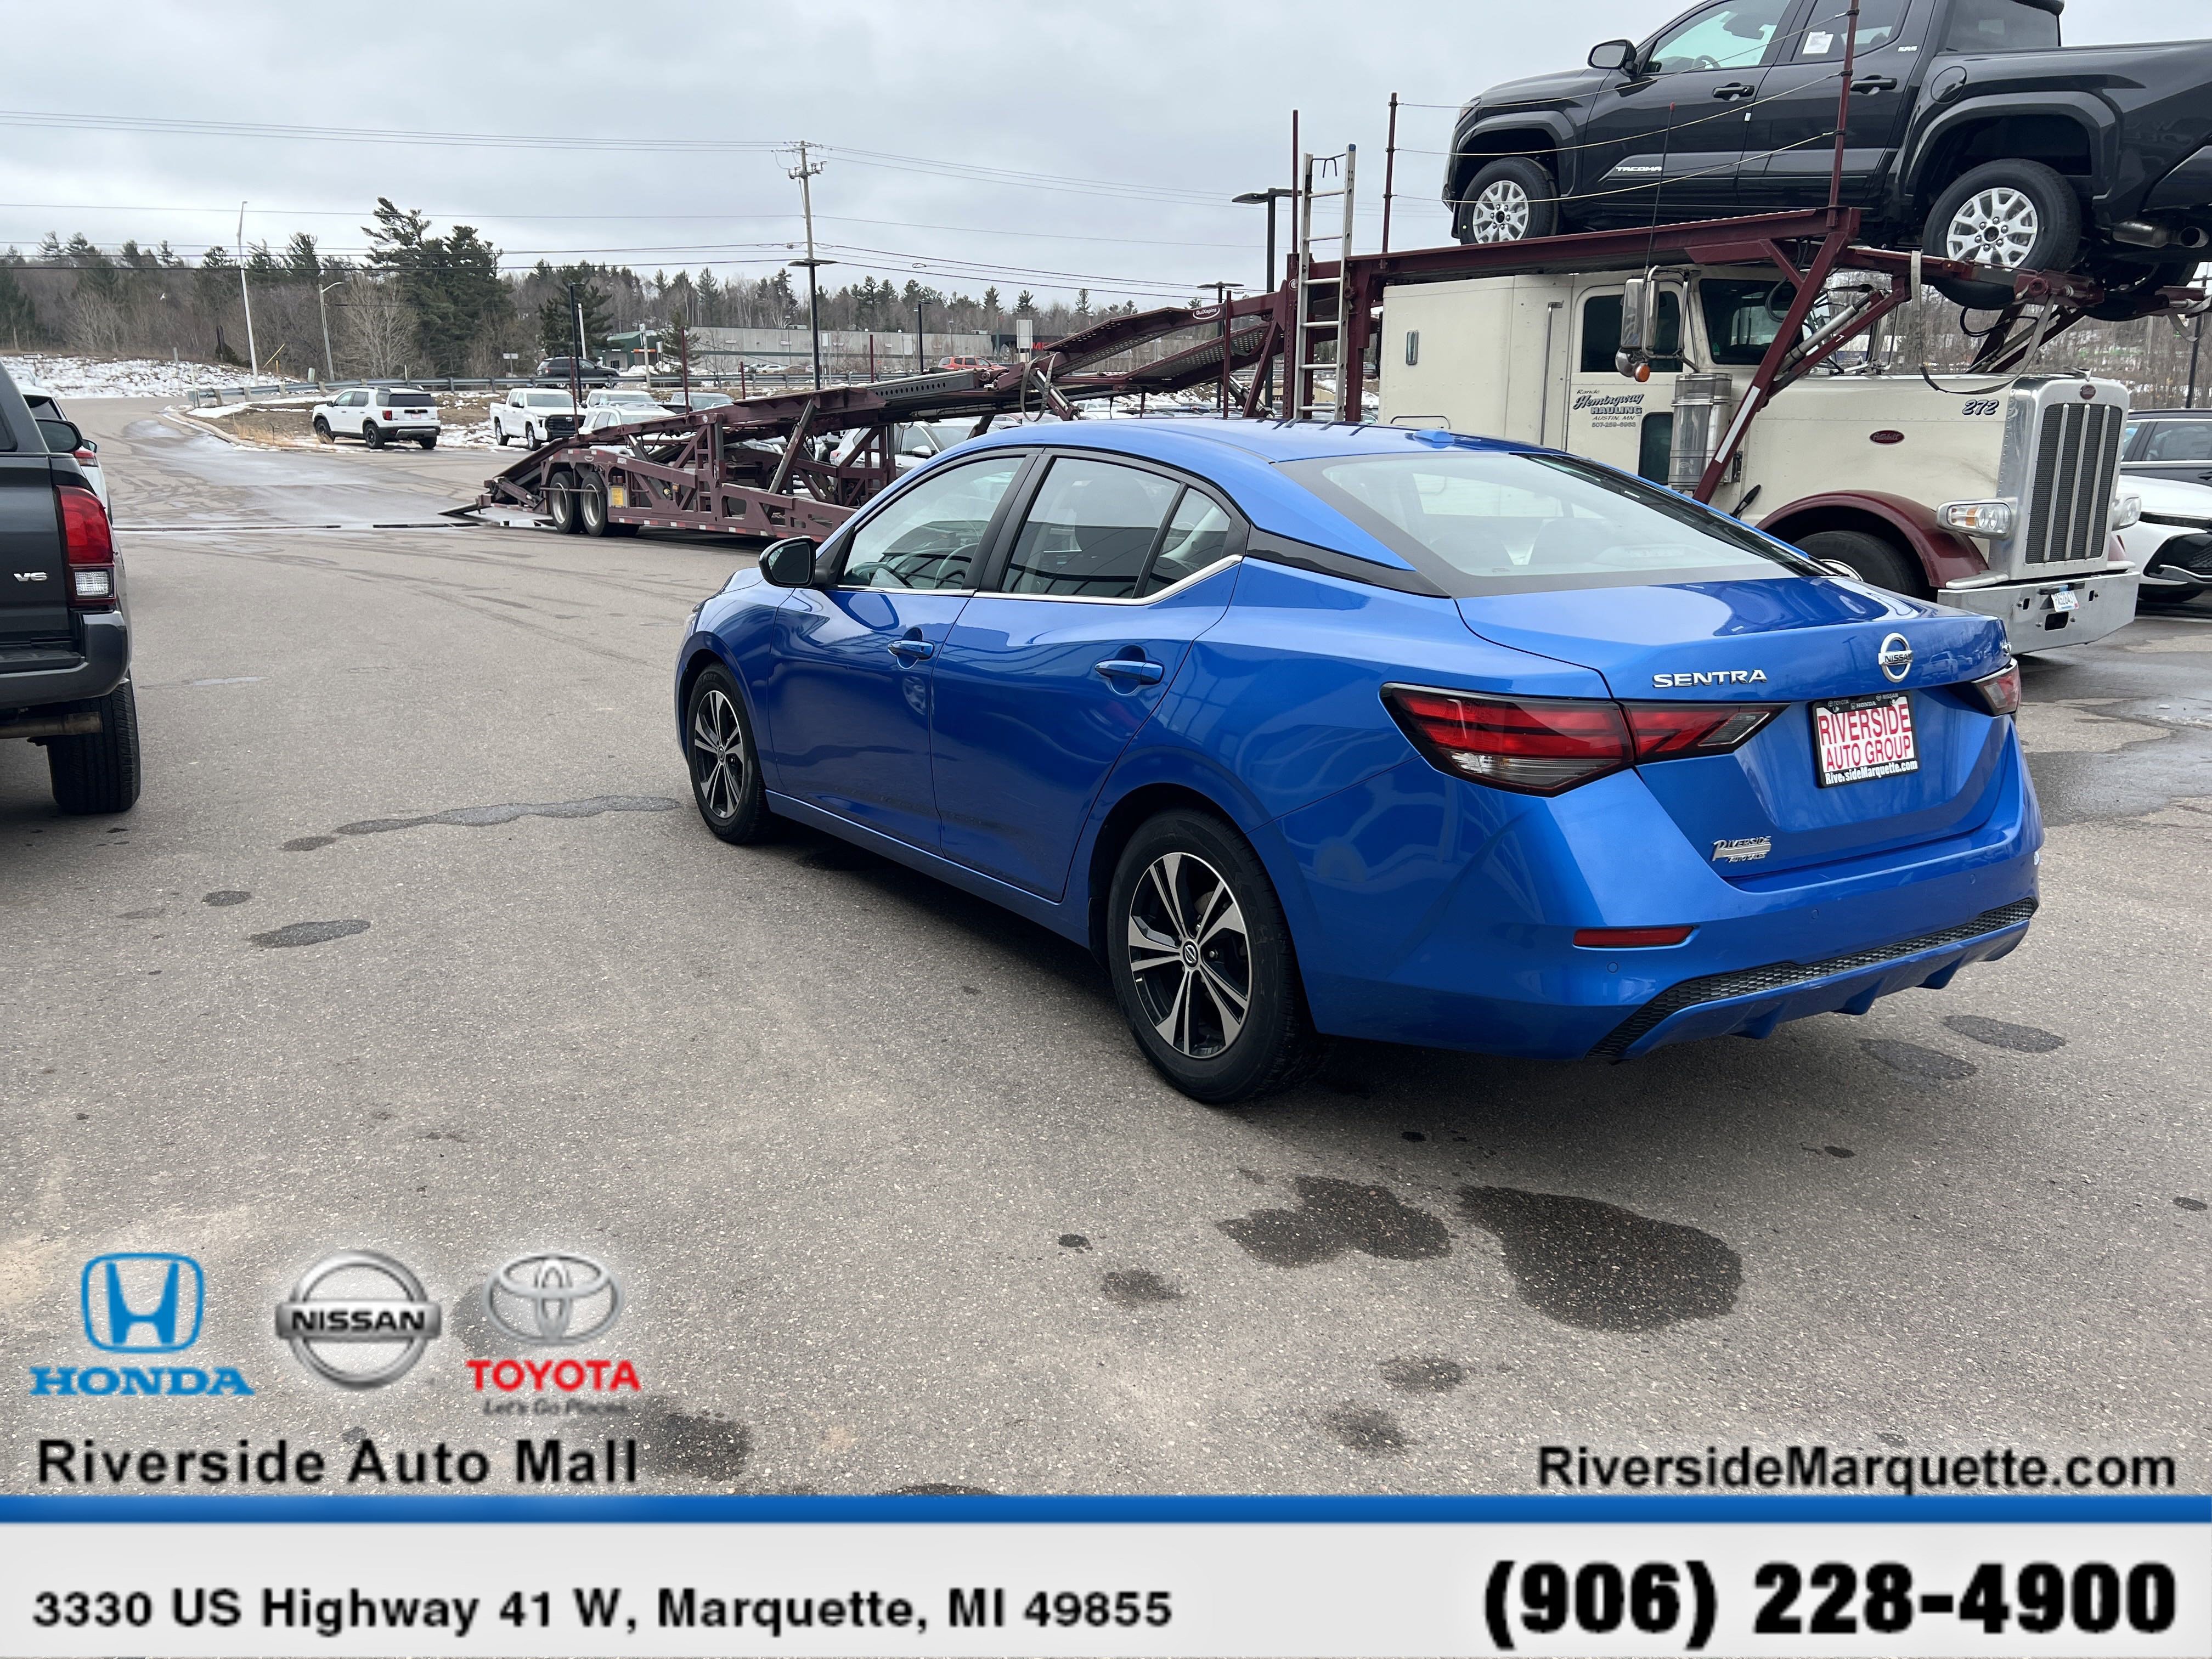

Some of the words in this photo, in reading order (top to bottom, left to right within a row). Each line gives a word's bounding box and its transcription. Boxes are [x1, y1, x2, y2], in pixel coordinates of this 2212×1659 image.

[1573, 393, 1645, 410] Hemingway
[1962, 399, 1999, 415] 272
[13, 572, 47, 582] V6
[1884, 654, 1911, 662] NISSAN
[1653, 669, 1768, 688] SENTRA
[1818, 703, 1911, 746] RIVERSIDE
[1826, 742, 1861, 771] AUTO
[1865, 735, 1911, 764] GROUP
[1712, 836, 1771, 861] RIVERSIDE
